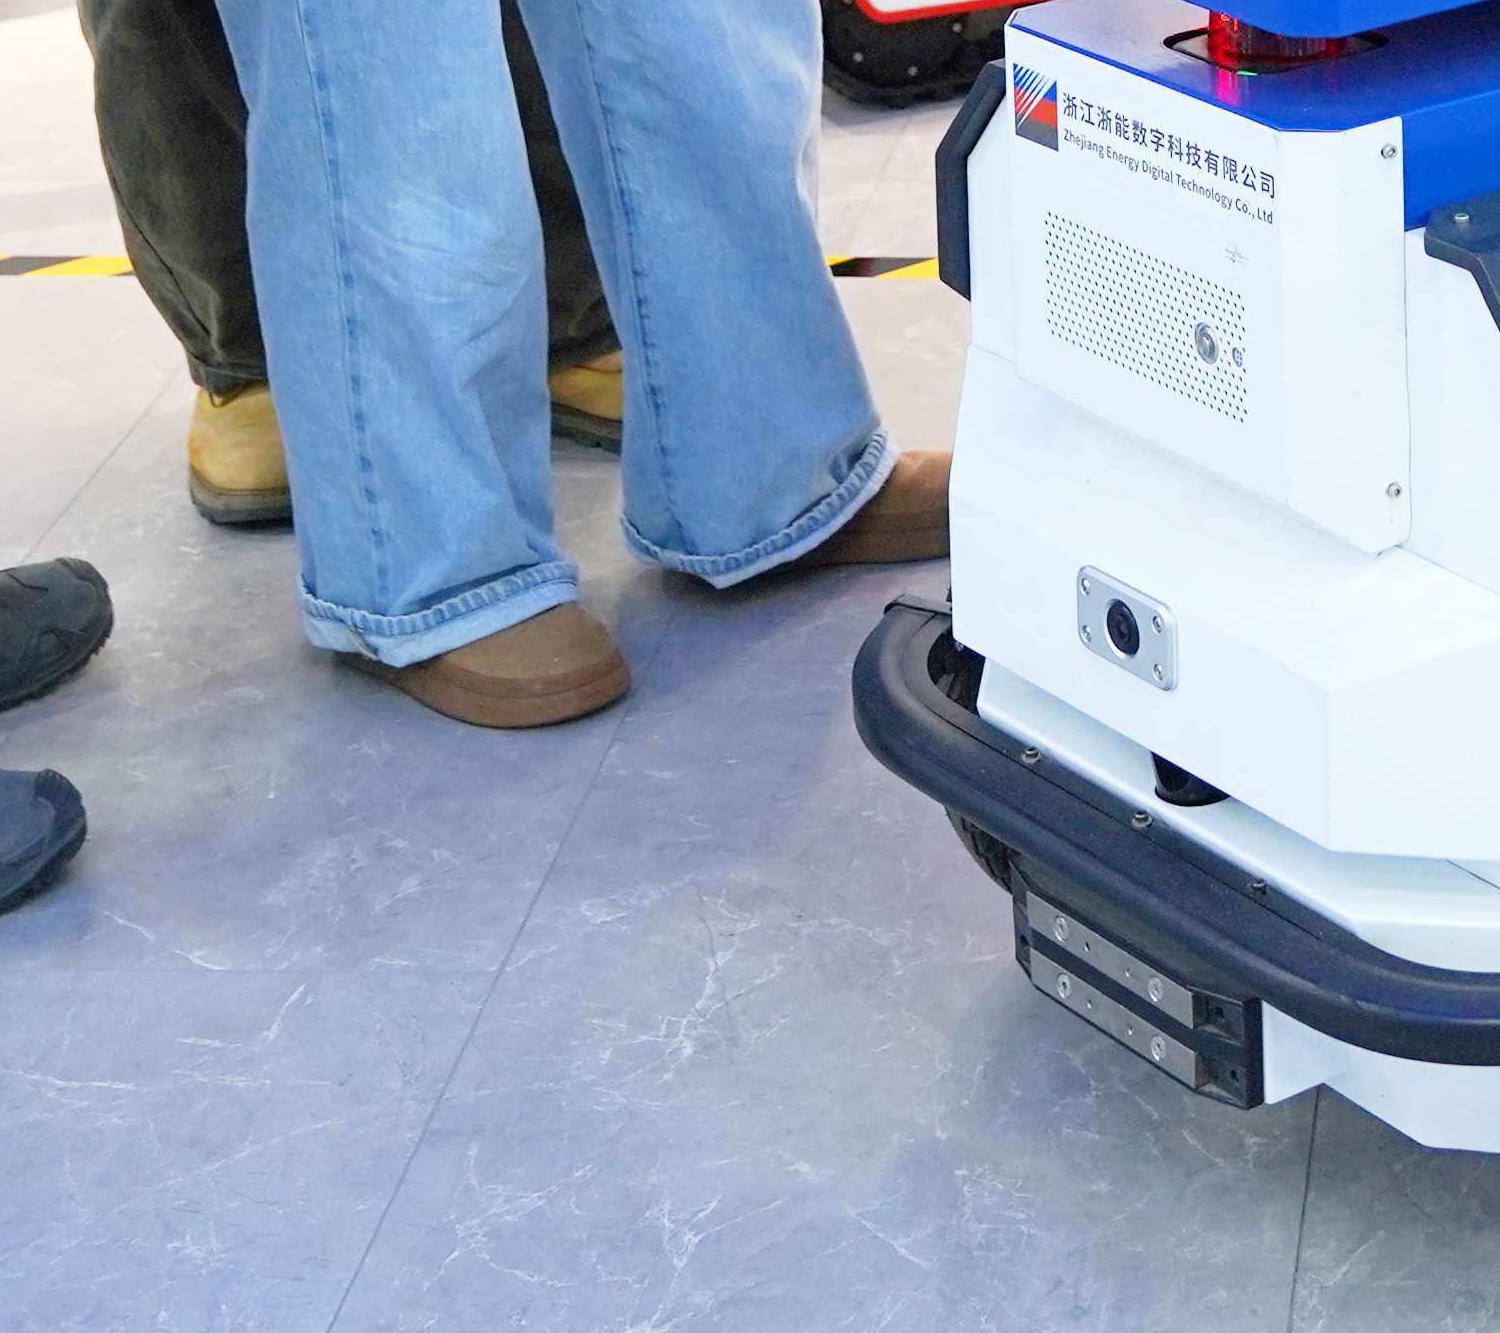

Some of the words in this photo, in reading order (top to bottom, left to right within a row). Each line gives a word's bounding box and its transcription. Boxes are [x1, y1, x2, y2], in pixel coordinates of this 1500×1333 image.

[1062, 92, 1276, 199] 浙江浙能数字科技有限公司
[1064, 129, 1104, 158] Zhejiang
[1107, 146, 1140, 172] Energy
[1142, 160, 1173, 183] Digital
[1176, 174, 1233, 210] Technology
[1258, 203, 1273, 224] Ltd
